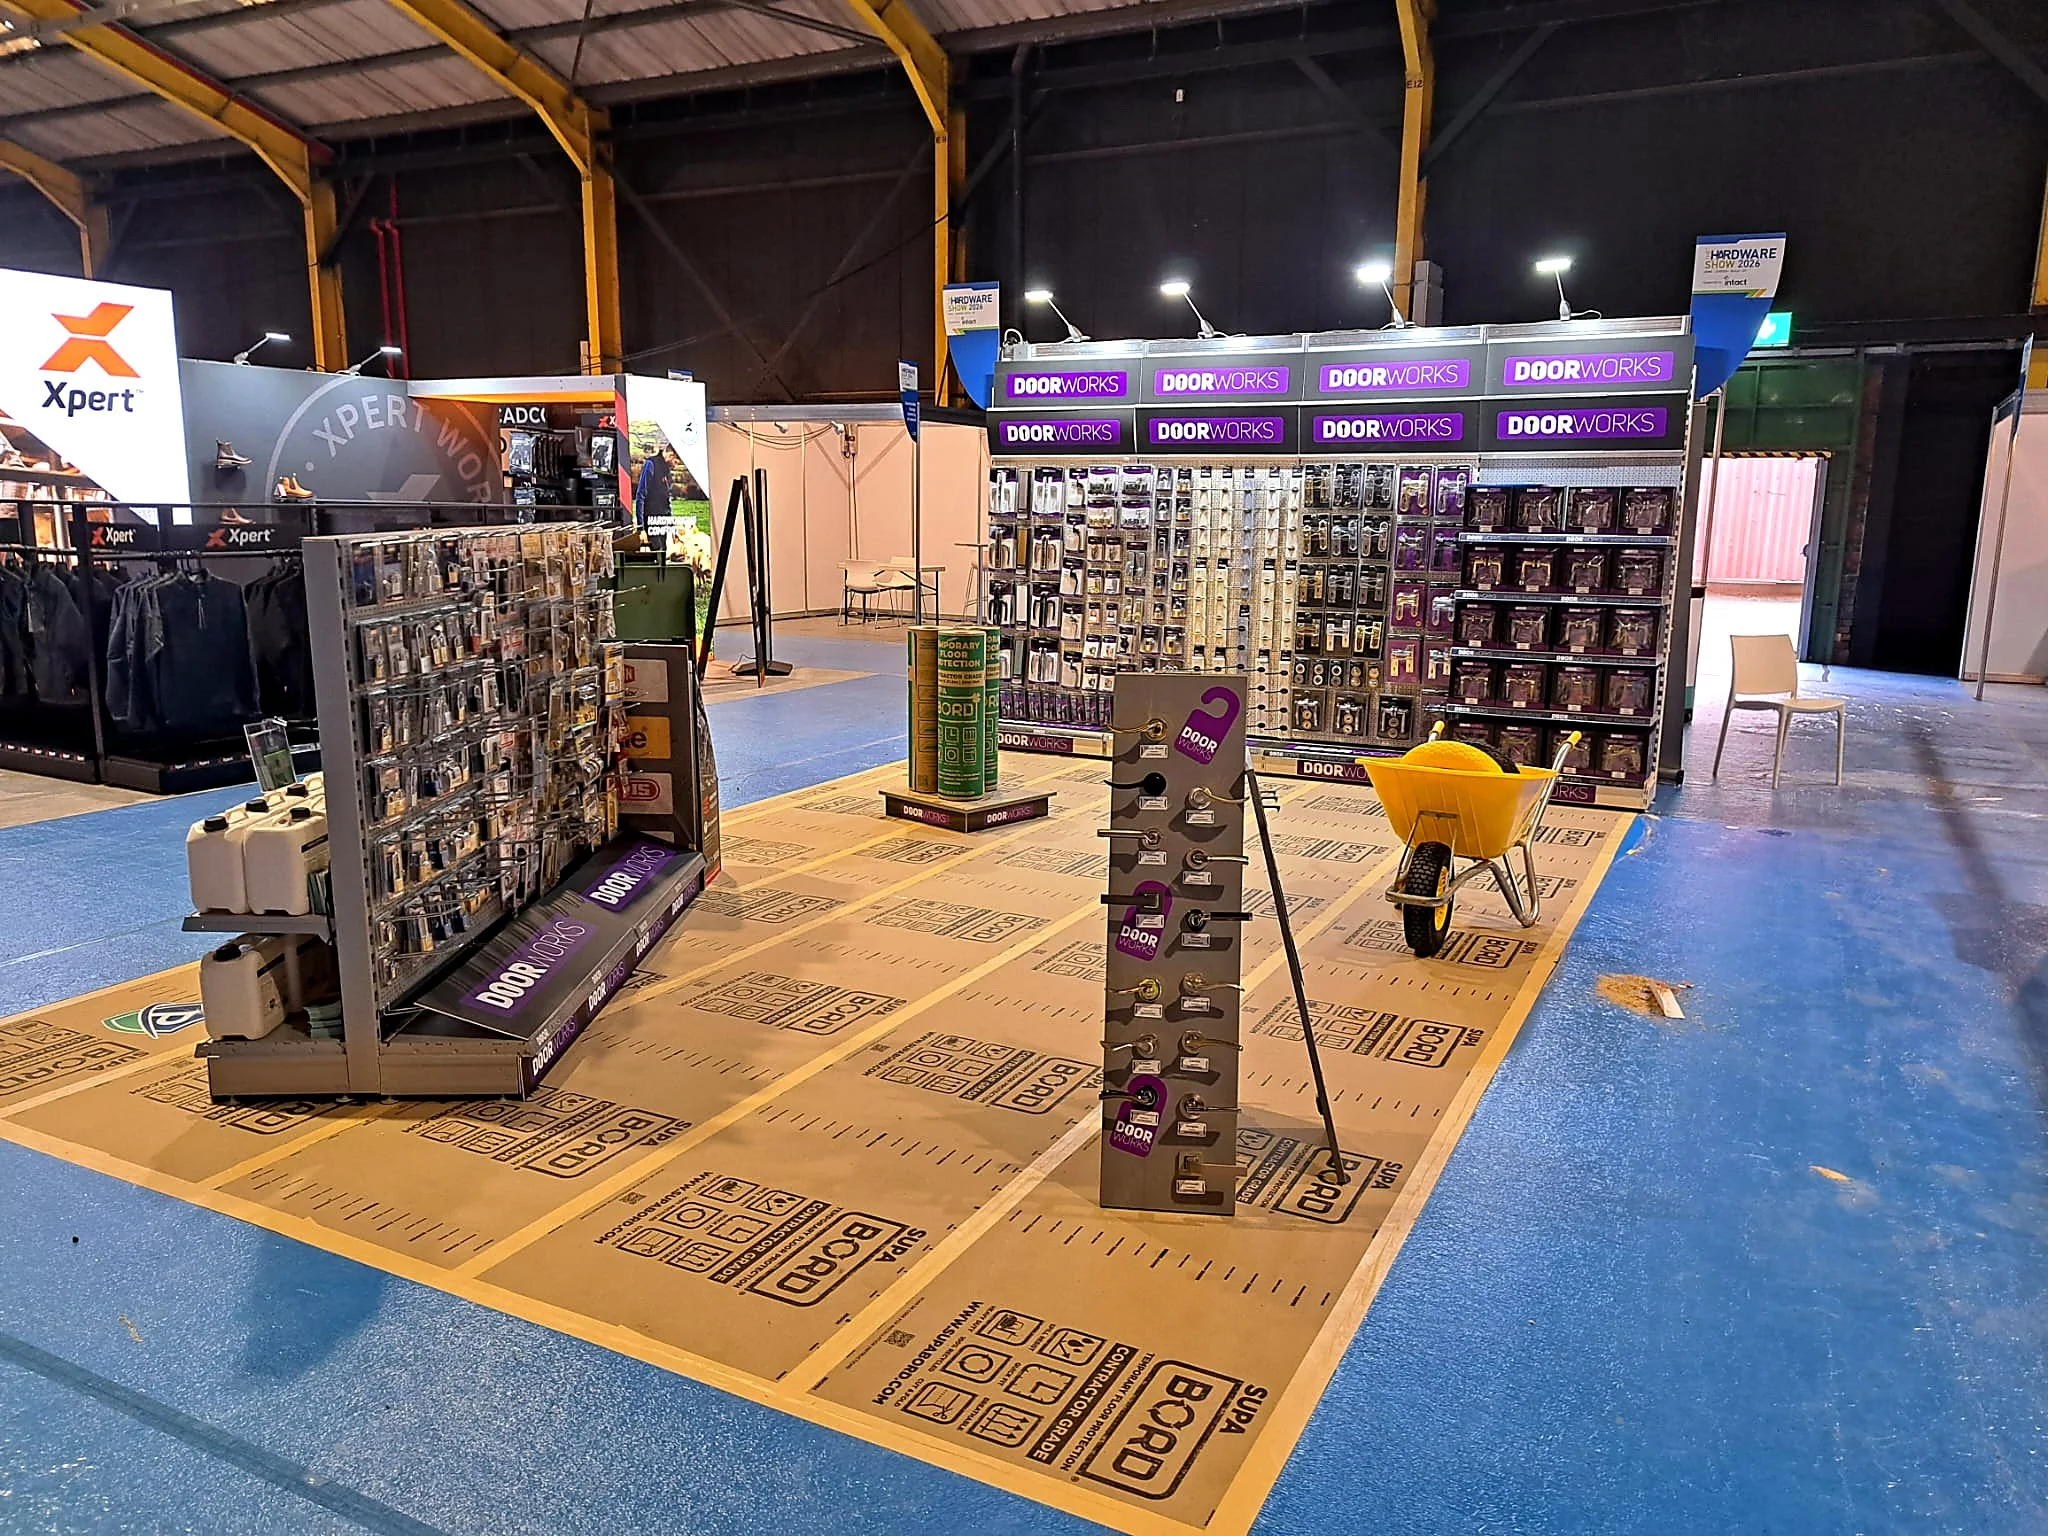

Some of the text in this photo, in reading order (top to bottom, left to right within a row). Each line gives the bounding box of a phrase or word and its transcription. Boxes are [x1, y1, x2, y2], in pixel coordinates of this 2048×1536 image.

[1705, 260, 1760, 269] SHOW 2026
[1710, 248, 1777, 260] HARDWARE
[1162, 371, 1280, 392] DOORWORKS
[1328, 364, 1460, 388] DOORWORKS
[1514, 356, 1662, 382] DOORWORKS
[1014, 374, 1120, 395] DOORWORKS
[42, 380, 134, 418] Xpert
[1006, 424, 1113, 442] DOORWORKS
[1158, 422, 1275, 440] DOORWORKS
[1322, 417, 1452, 440] DOORWORKS
[1508, 412, 1656, 436] DOORWORKS
[312, 394, 492, 504] XPERT WOR
[106, 526, 134, 544] Xpert
[228, 528, 270, 546] Xpert
[938, 660, 980, 668] OTECTION
[1178, 736, 1212, 760] WORKS
[1182, 726, 1218, 753] DOOR
[1304, 762, 1368, 778] DOORWO
[589, 846, 666, 905] DOORWORKS
[1120, 925, 1158, 948] DOOR
[1120, 937, 1154, 956] WORKS
[475, 920, 586, 1010] DOORWORKS
[588, 961, 626, 1011] DOORWORKS
[804, 996, 877, 1030] BORD
[532, 1016, 578, 1077] DOORWORKS
[1404, 1024, 1452, 1062] BORD
[1460, 1028, 1484, 1047] SUPA
[88, 1050, 150, 1071] SUPA
[1012, 1064, 1080, 1108] BORD
[548, 1116, 650, 1170] BORD
[640, 1120, 692, 1147] SUPA
[1112, 1132, 1150, 1152] WORKS
[1114, 1120, 1153, 1144] DOOR
[1370, 1161, 1403, 1190] SUPA
[594, 1170, 714, 1245] WWW.SUPABORD.COM
[714, 1202, 826, 1283] CONTRACTOR GRADE
[874, 1226, 928, 1264] SUPA
[776, 1221, 884, 1294] BORD
[872, 1300, 984, 1406] WWW.SUPABORD.COM
[957, 1397, 989, 1430] BREATHABLE
[1032, 1346, 1130, 1462] CONTRACTOR GRADE
[1060, 1352, 1156, 1472] TEMPORARY FLOOR PROTECTION
[1219, 1383, 1269, 1436] SUPA
[1112, 1374, 1214, 1482] BORD
